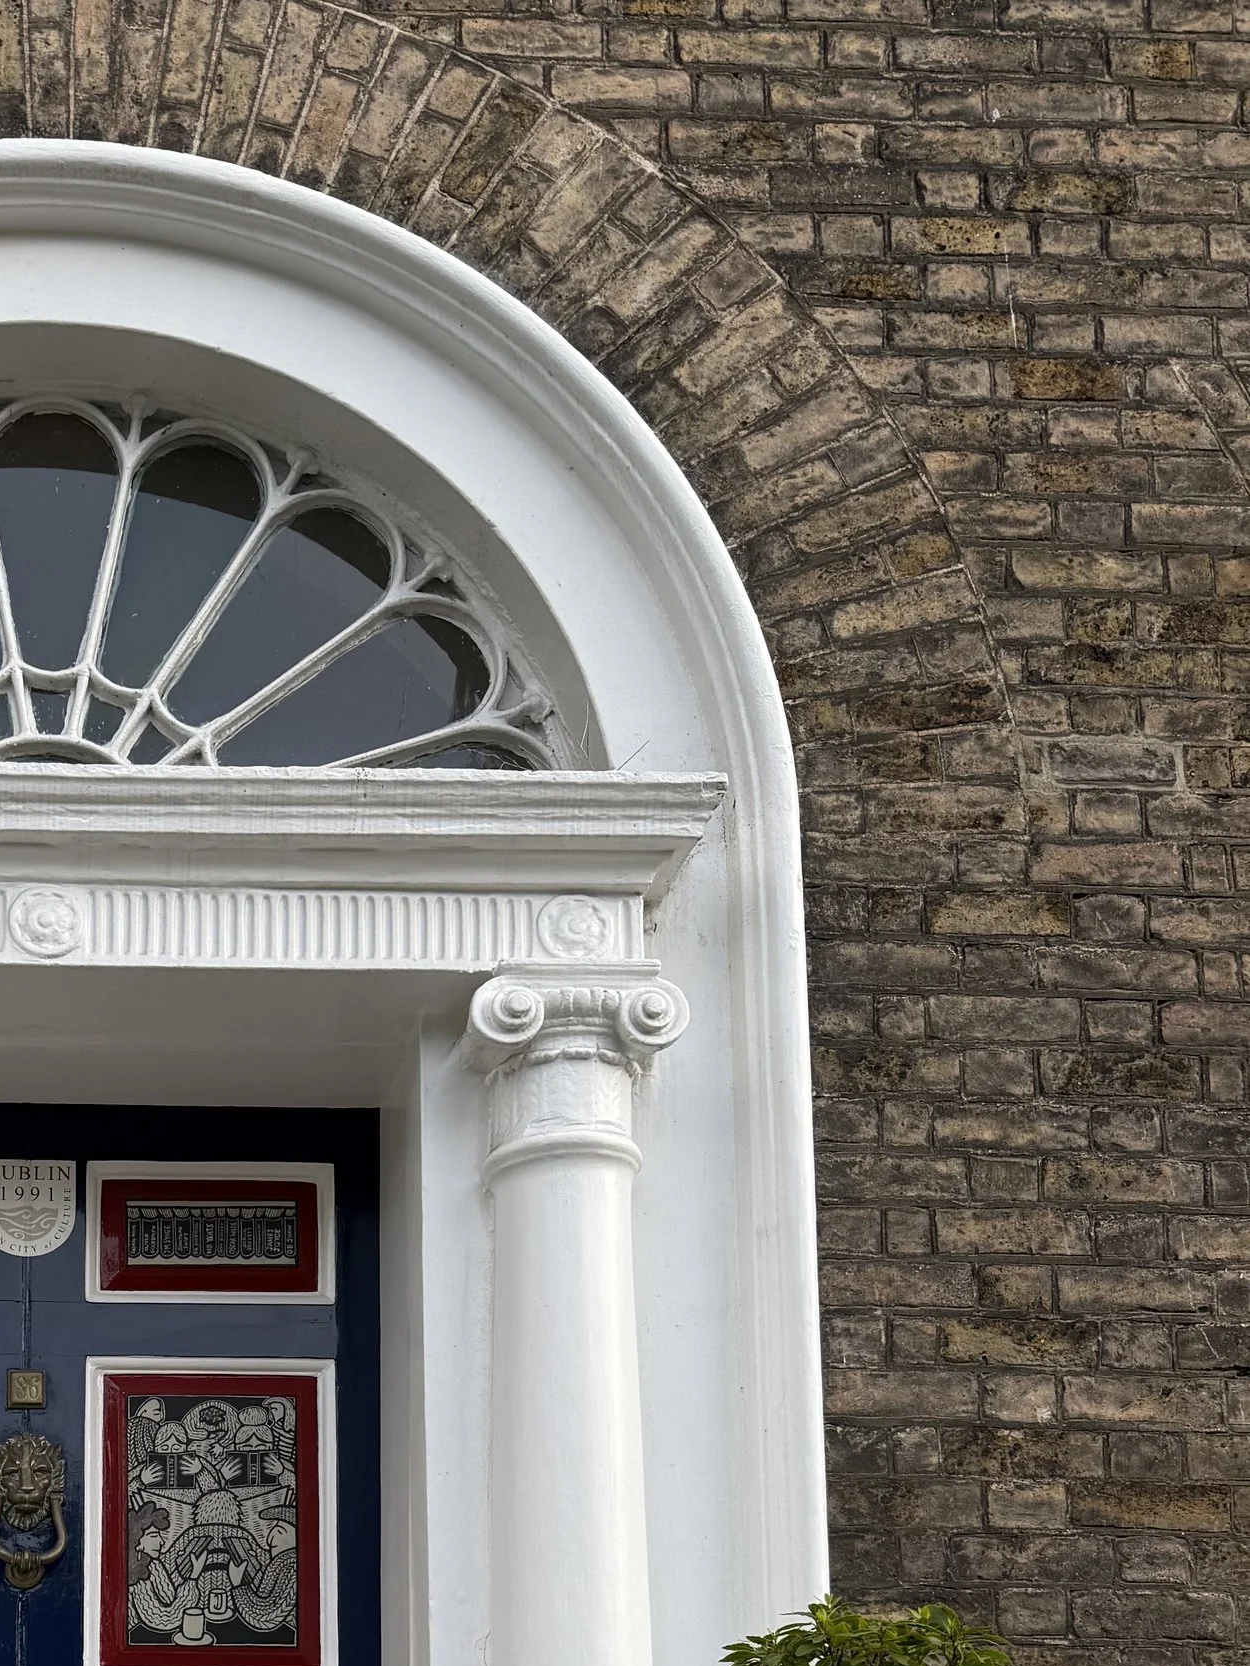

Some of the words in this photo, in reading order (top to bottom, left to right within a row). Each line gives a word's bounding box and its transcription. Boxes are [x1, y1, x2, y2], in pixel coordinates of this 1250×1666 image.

[1, 1186, 54, 1202] 1991
[9, 1244, 38, 1253] CITY
[54, 1187, 71, 1240] CULTURE
[206, 1223, 214, 1243] YEATS
